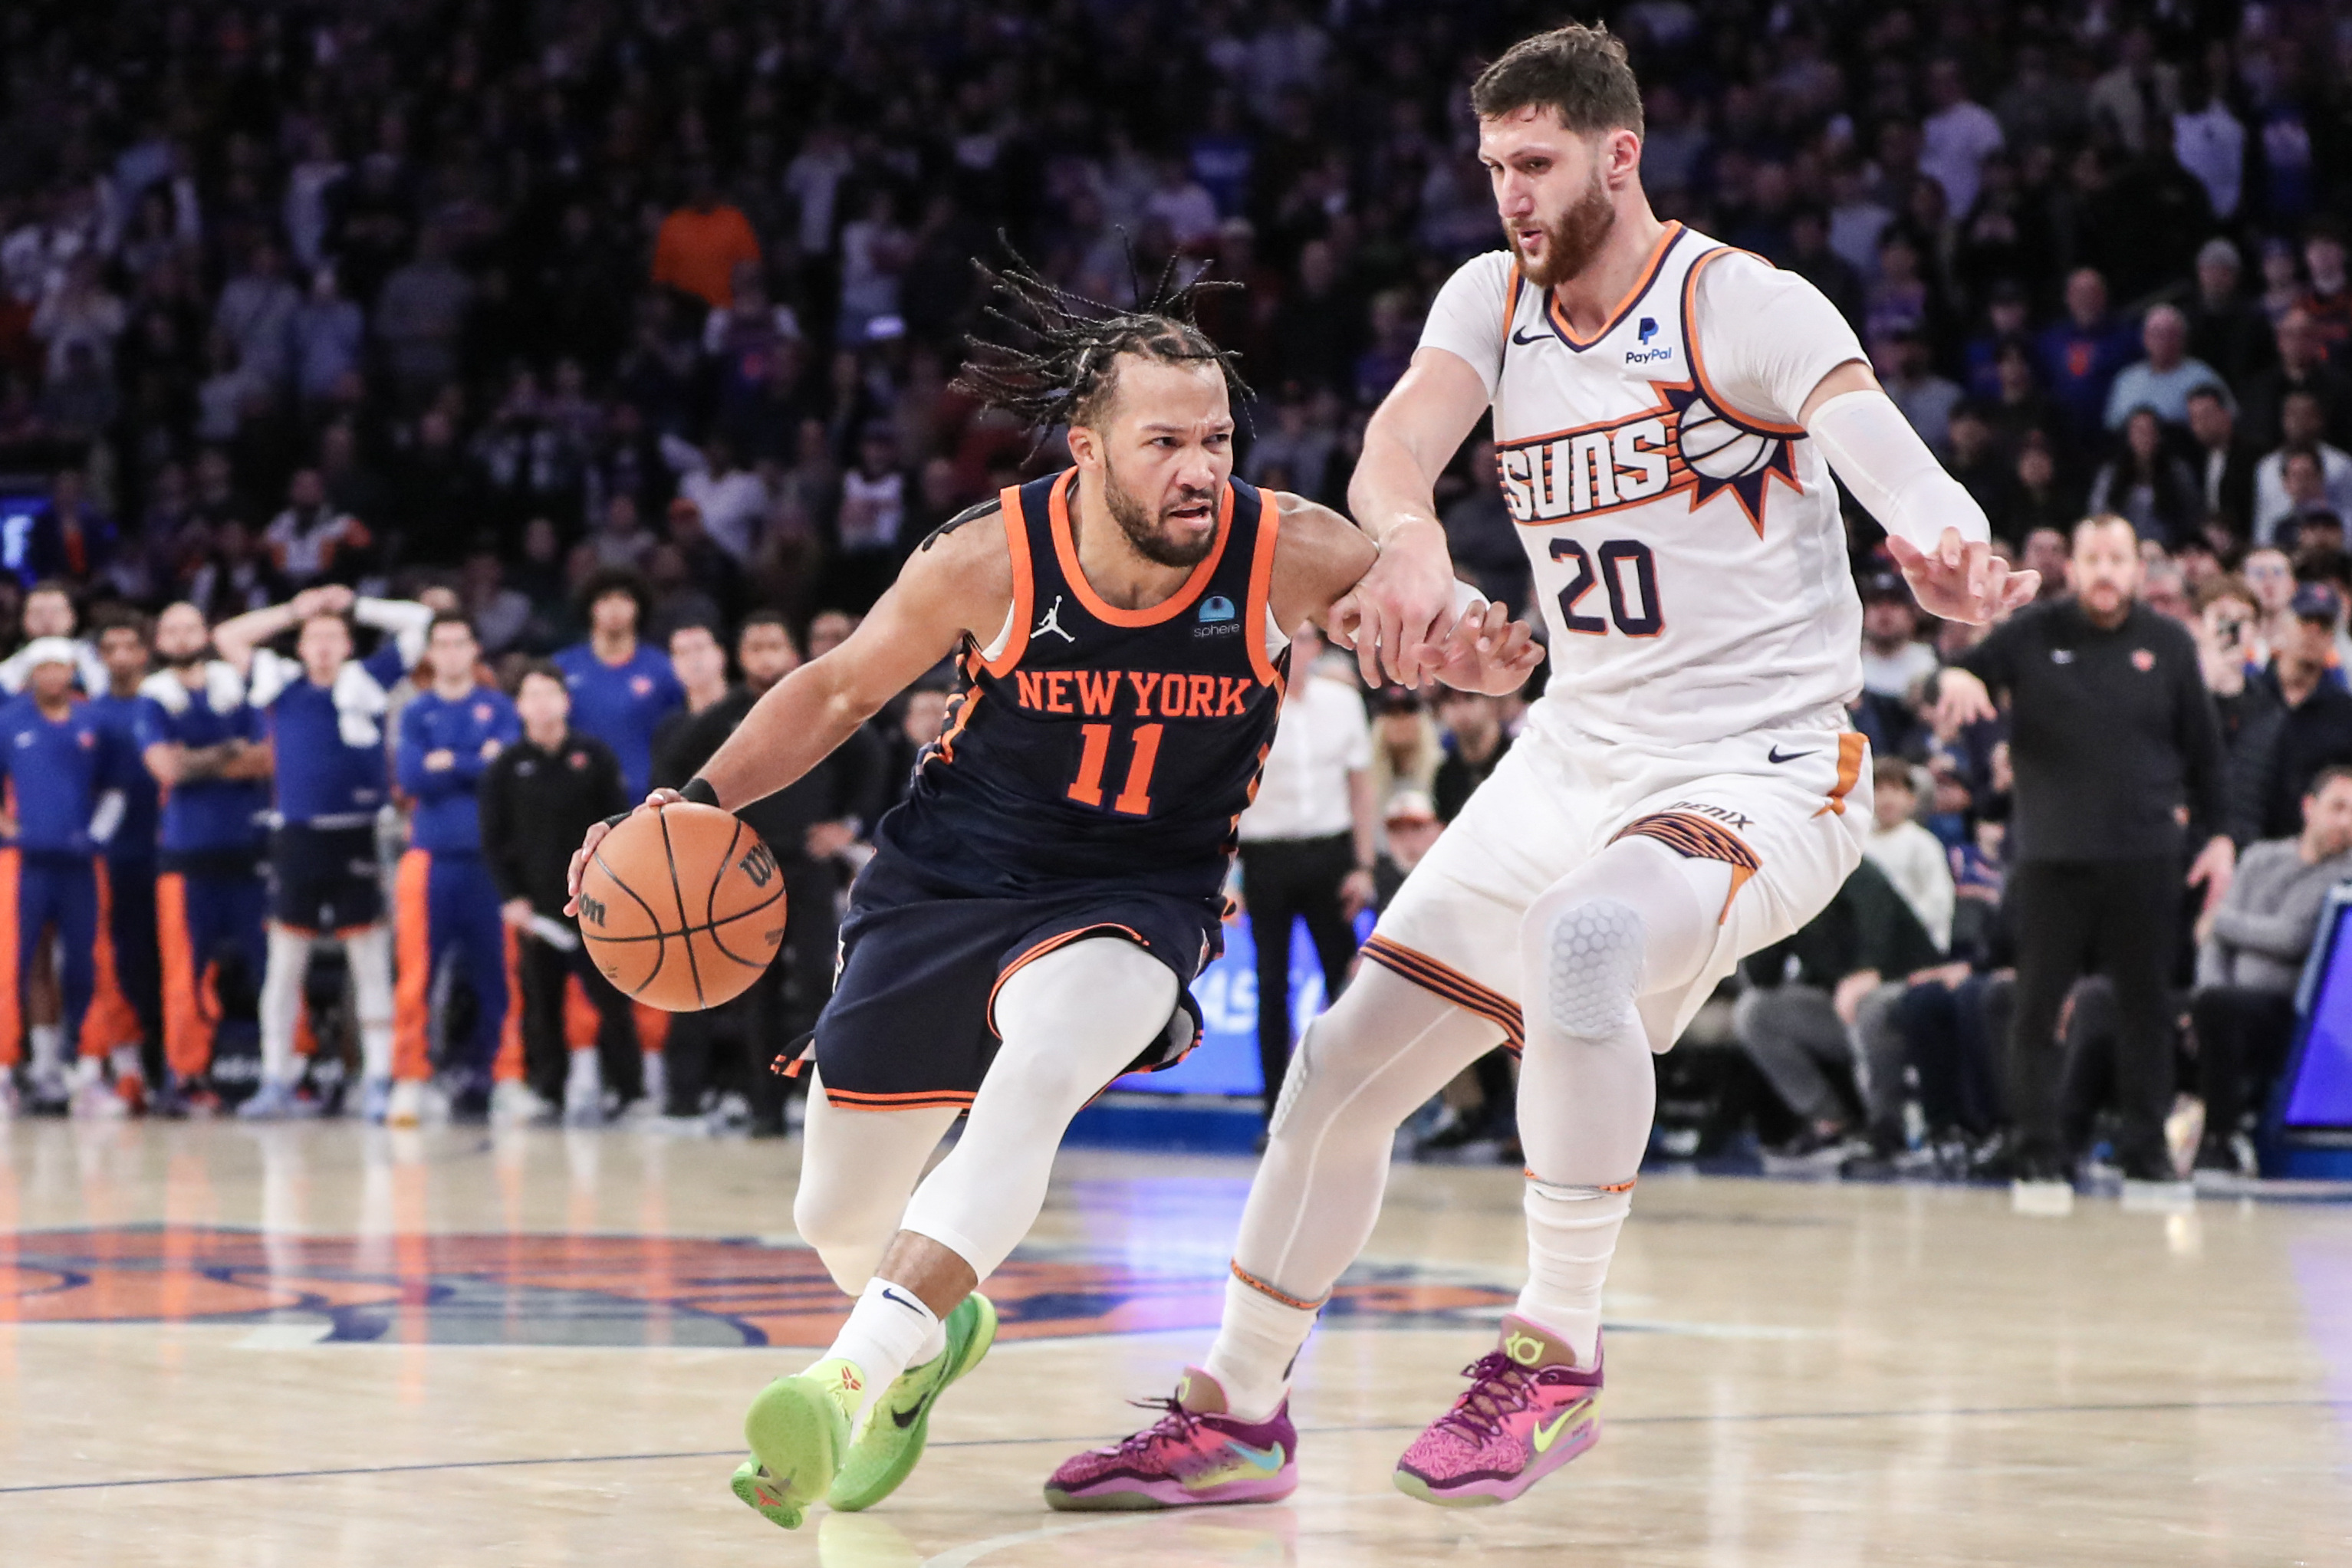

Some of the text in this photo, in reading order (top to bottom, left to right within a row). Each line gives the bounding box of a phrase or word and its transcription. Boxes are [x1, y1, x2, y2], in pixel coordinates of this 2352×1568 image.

[1625, 347, 1673, 364] PayPal
[1501, 418, 1671, 522] SUNS
[1548, 537, 1666, 639] 20
[1193, 623, 1241, 638] sphere
[1014, 669, 1252, 718] NEW YORK
[1066, 722, 1165, 817] 11
